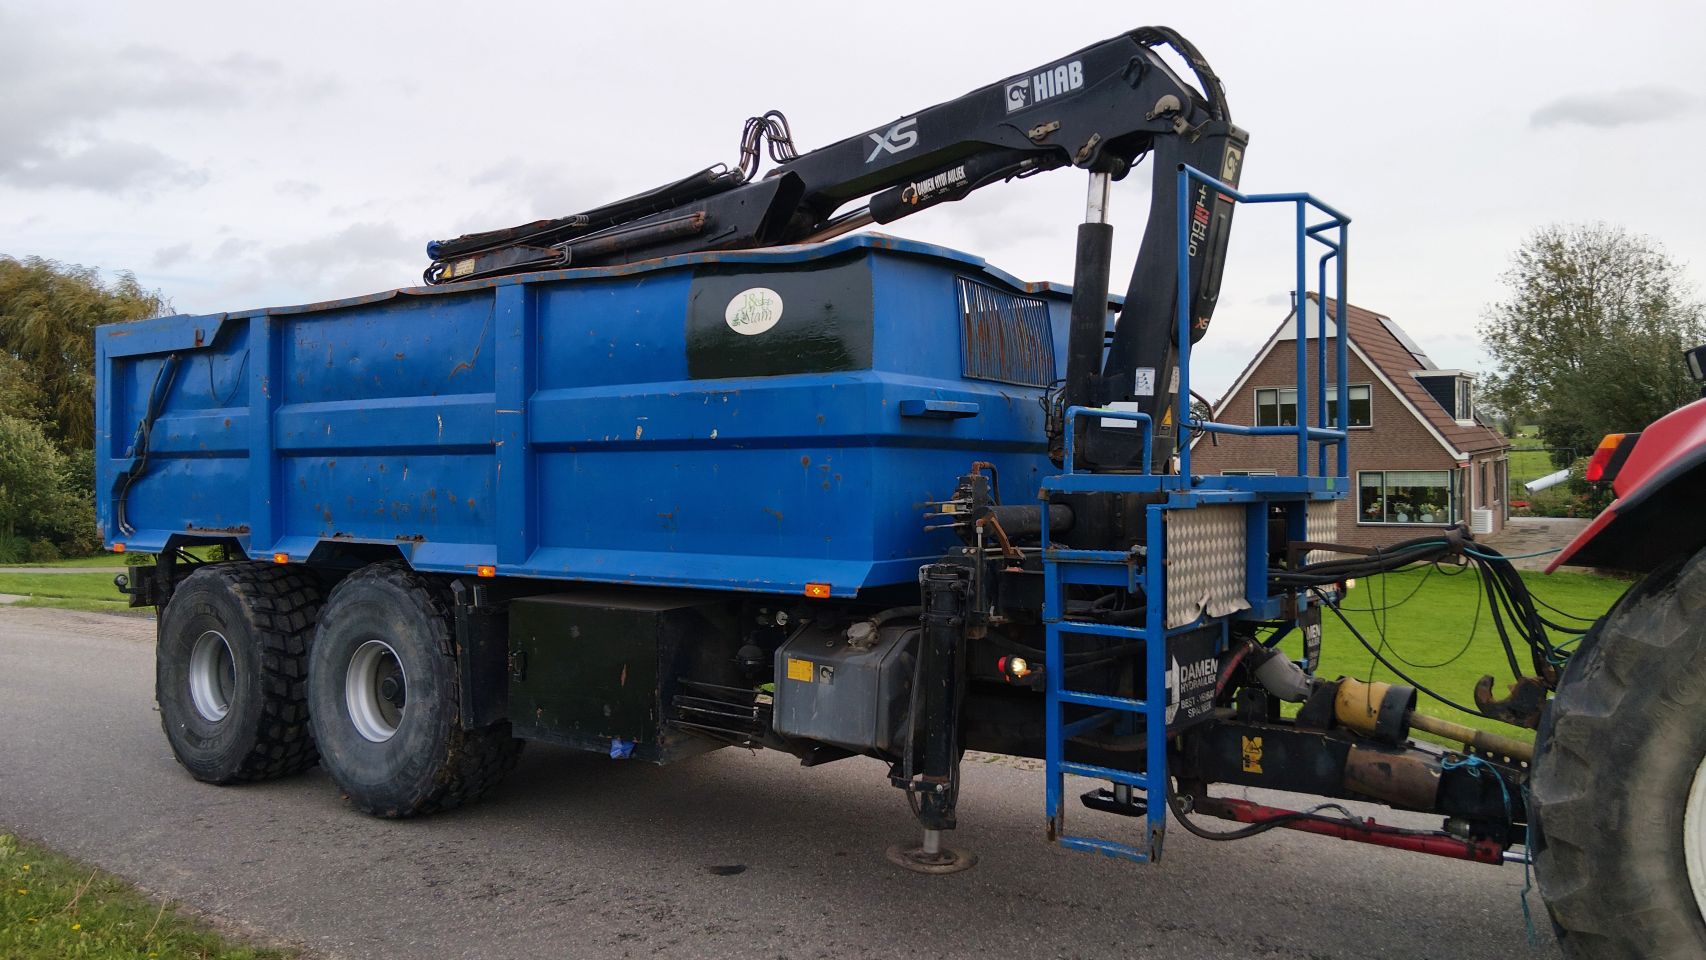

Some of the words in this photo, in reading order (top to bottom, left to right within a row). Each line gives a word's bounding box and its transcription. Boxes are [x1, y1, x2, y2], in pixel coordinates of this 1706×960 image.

[1032, 60, 1084, 102] HIAB
[865, 118, 918, 164] XS
[916, 176, 936, 196] DAMEN
[1181, 658, 1218, 682] DAMEN
[1180, 696, 1196, 710] BEST
